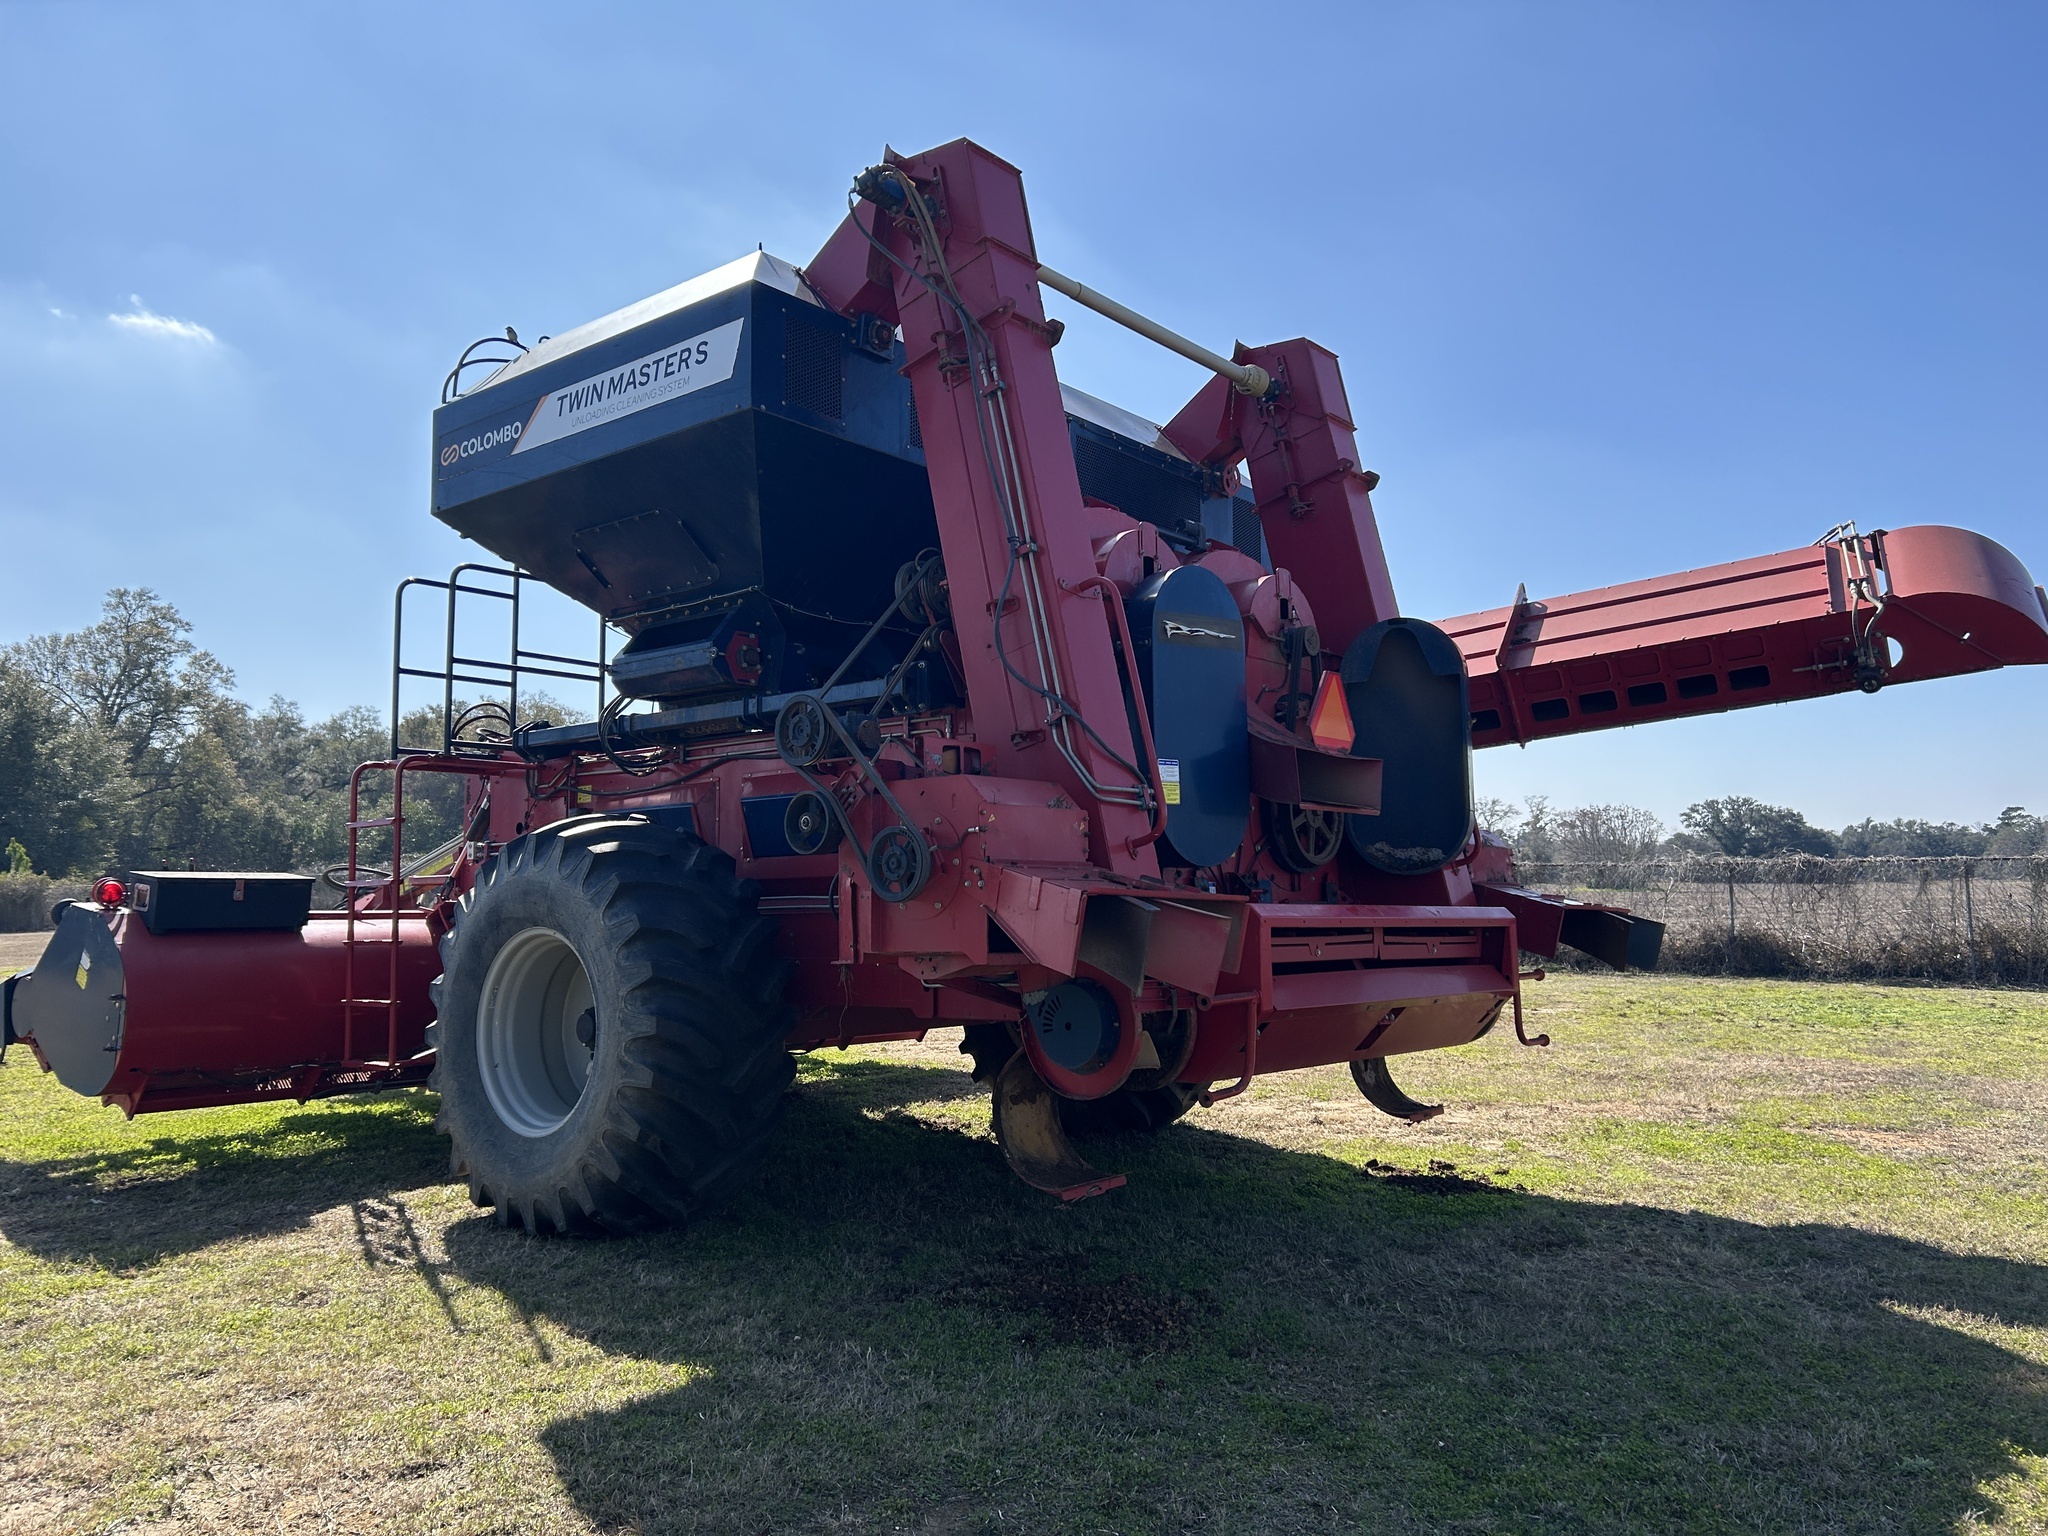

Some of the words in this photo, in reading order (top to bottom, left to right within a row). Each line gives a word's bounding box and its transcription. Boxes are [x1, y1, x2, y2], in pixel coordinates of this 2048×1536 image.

[557, 380, 604, 417] TWIN
[607, 341, 709, 399] MASTERS
[571, 403, 615, 427] UNLOADING
[616, 388, 657, 411] CLEANING
[658, 376, 690, 396] SYSTEM
[460, 421, 521, 458] COLOMBO
